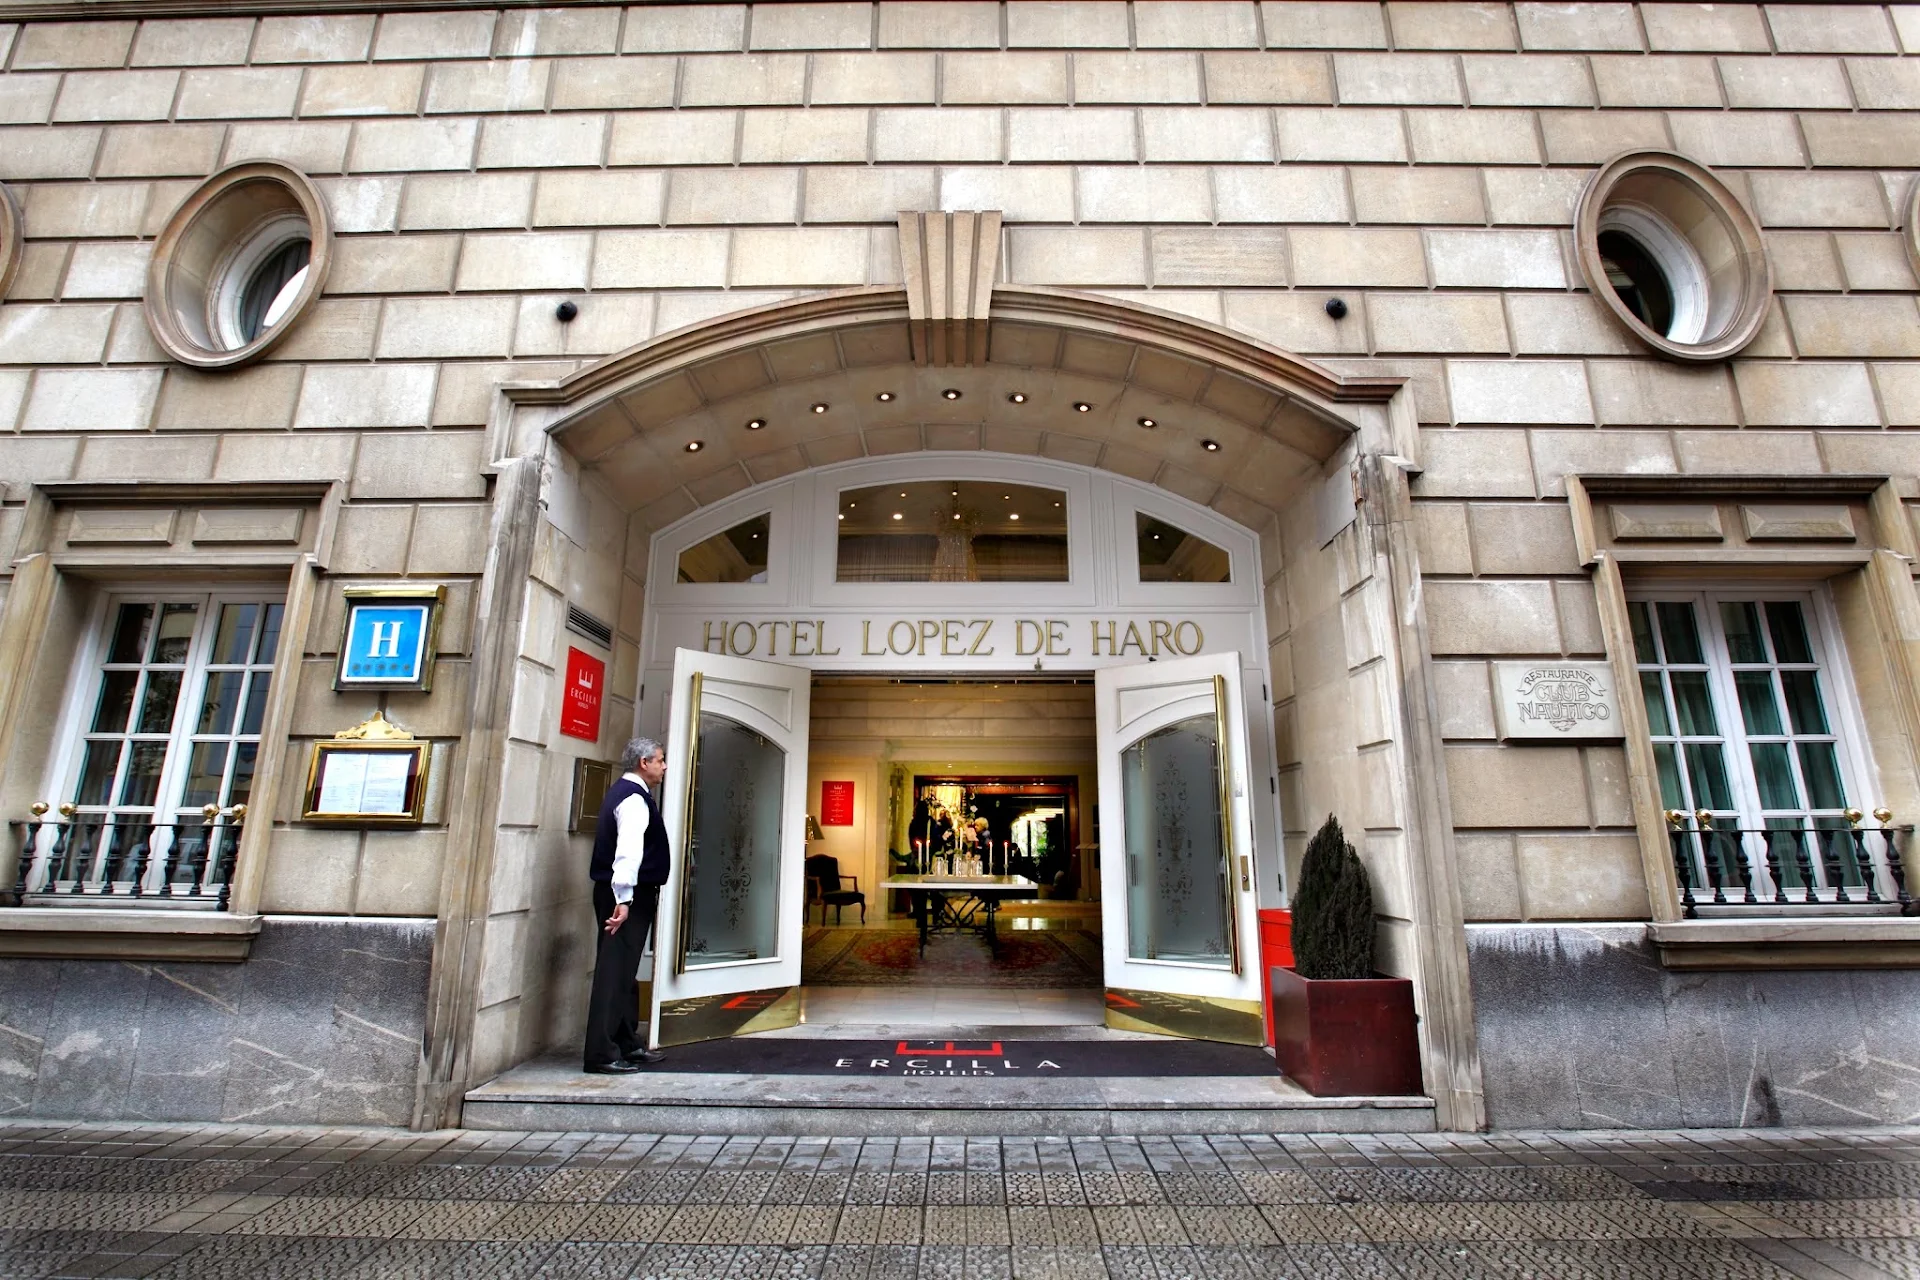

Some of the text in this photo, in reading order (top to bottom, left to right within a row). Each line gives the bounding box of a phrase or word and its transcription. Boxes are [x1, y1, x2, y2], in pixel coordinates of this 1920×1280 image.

[367, 621, 404, 658] H
[703, 620, 1204, 656] HOTEL LOPEZ DE HARO
[1524, 669, 1596, 686] RESTAURANTE
[570, 687, 597, 706] ERCILLA
[1535, 683, 1590, 702] CLUB
[1517, 700, 1611, 723] NAUTICO
[835, 1058, 1061, 1069] ERCILLA
